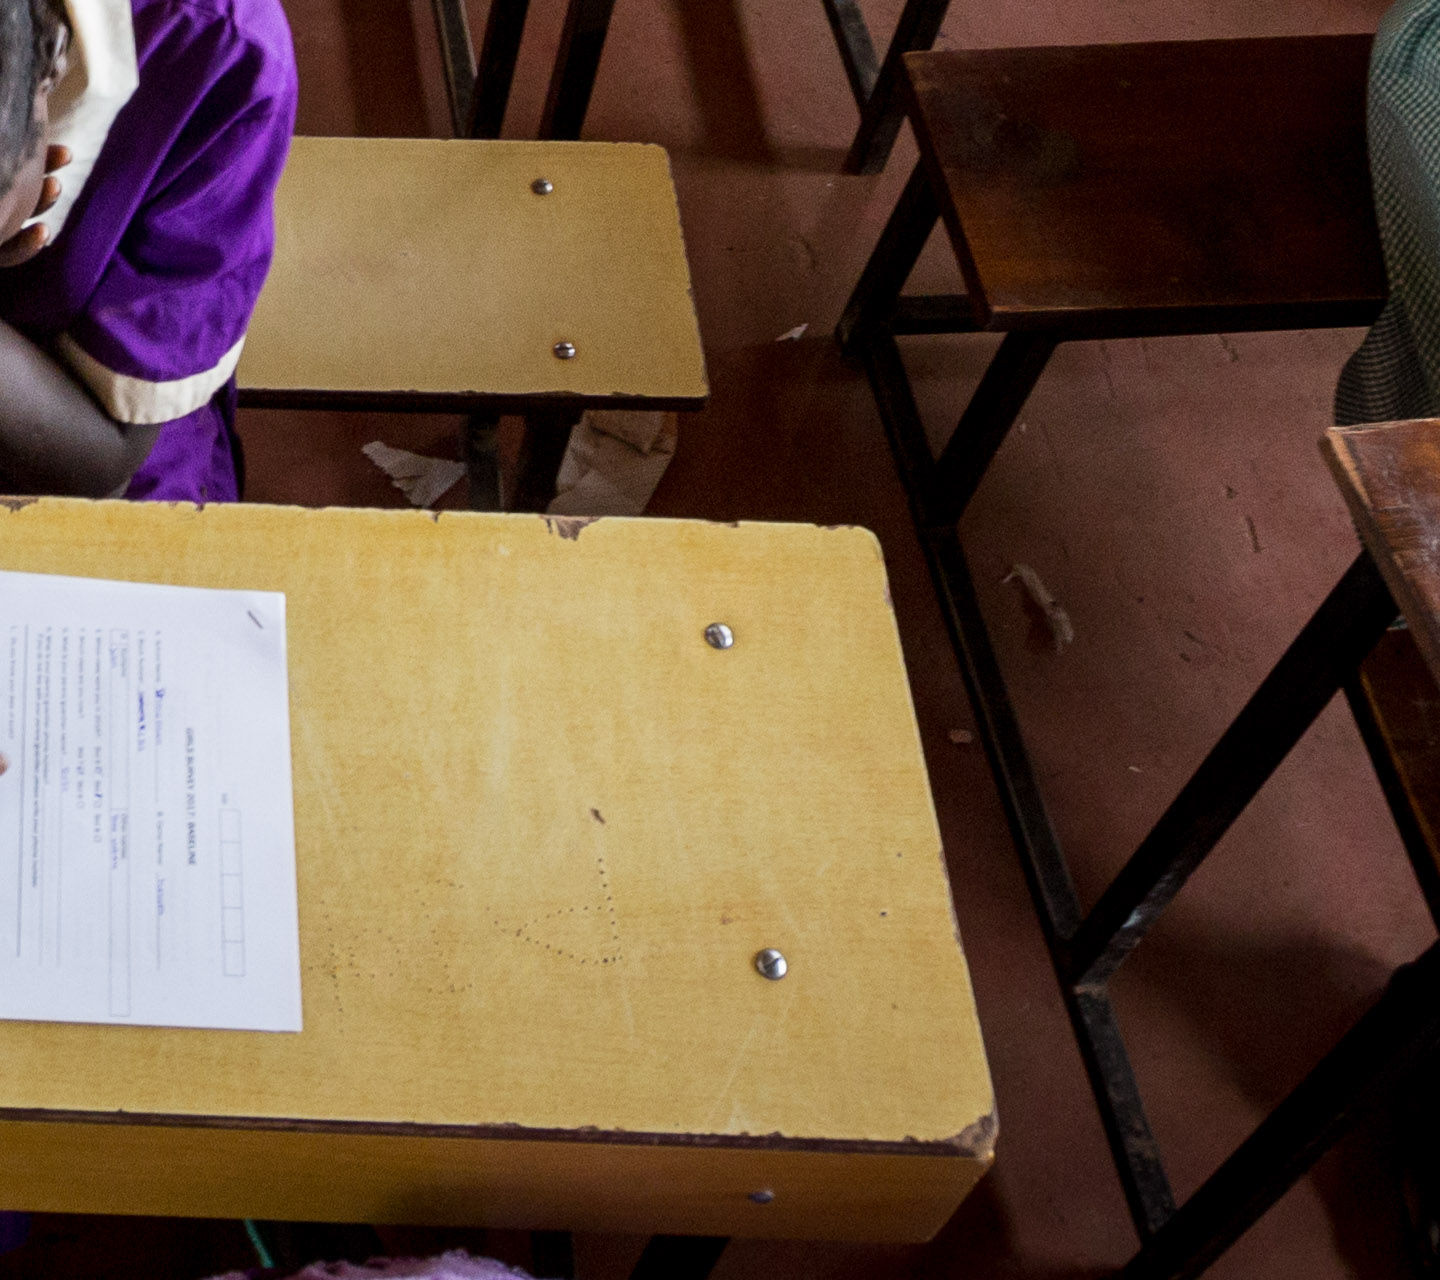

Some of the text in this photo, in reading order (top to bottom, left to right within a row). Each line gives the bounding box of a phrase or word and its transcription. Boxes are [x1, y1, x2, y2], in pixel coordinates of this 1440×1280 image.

[184, 727, 195, 753] GIRLS
[185, 755, 195, 790] SURVEY
[186, 821, 197, 866] BASELINE
